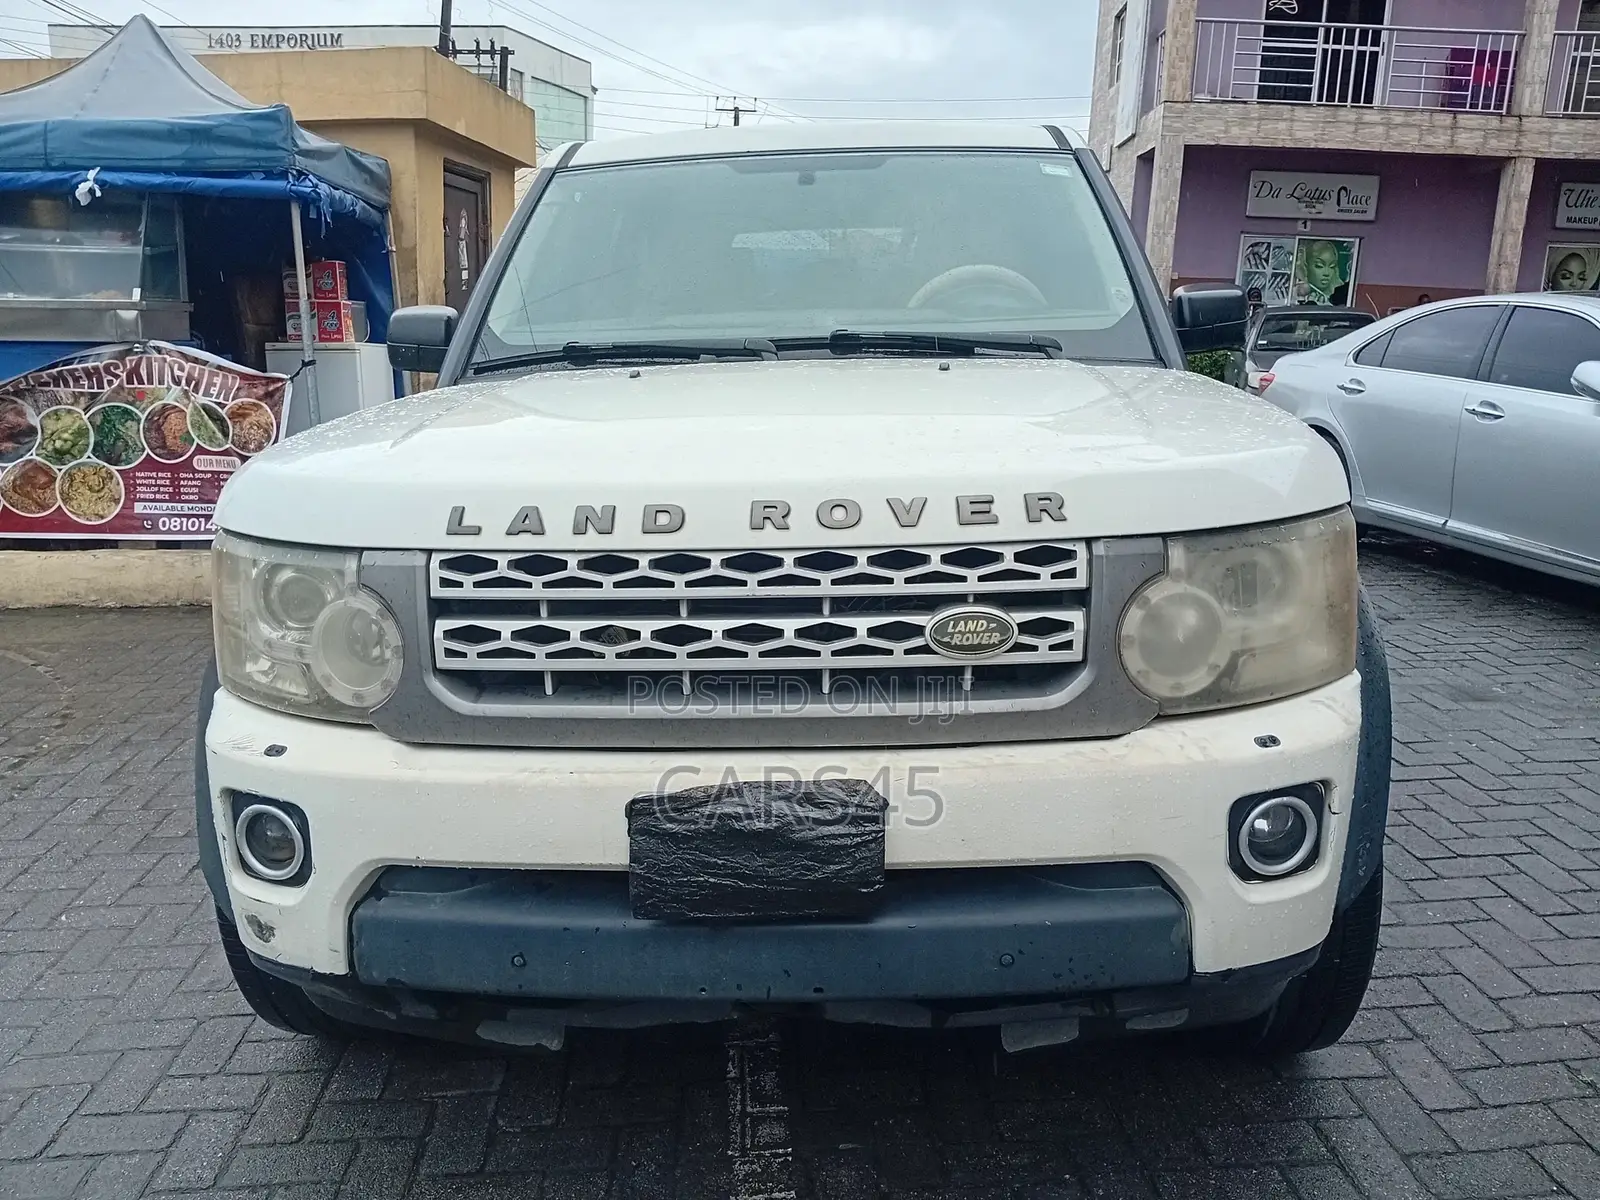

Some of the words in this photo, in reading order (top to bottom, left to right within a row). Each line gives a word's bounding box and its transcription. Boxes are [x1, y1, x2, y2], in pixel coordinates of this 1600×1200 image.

[207, 32, 242, 49] 1403
[249, 33, 344, 50] EMPORIUM
[1253, 180, 1283, 199] Da
[1285, 181, 1335, 201] Lotus
[1336, 185, 1372, 207] Place
[1301, 220, 1307, 229] 1
[323, 269, 332, 280] 4
[328, 310, 337, 320] 4
[124, 355, 239, 403] KITCHEN
[196, 457, 214, 468] OUR
[215, 458, 237, 469] MENU
[142, 504, 186, 512] AVAILABLE
[446, 503, 687, 535] LAND
[749, 491, 1068, 530] ROVER
[951, 632, 1000, 645] ROVER
